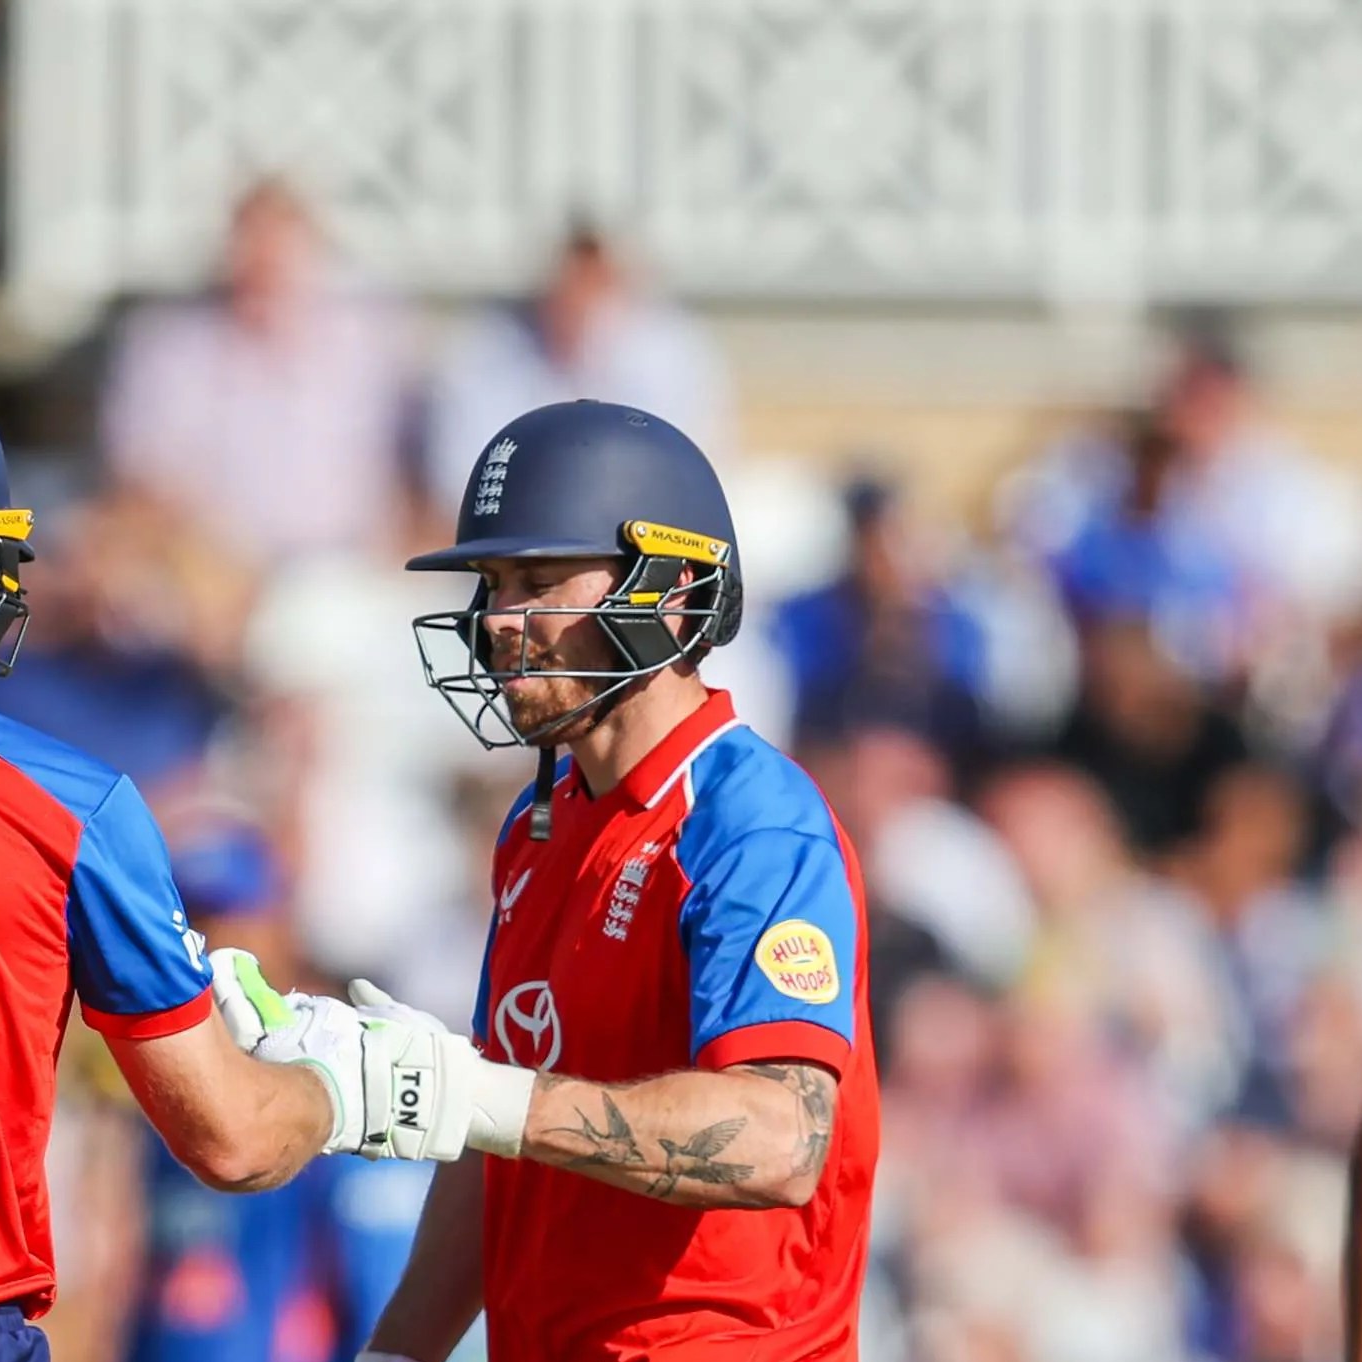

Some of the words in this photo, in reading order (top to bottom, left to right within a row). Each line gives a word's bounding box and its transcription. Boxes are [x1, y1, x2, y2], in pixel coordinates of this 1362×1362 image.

[651, 530, 705, 550] MASURI
[772, 936, 821, 963] HULA
[779, 964, 831, 991] HOOPS
[398, 1071, 421, 1127] TON
